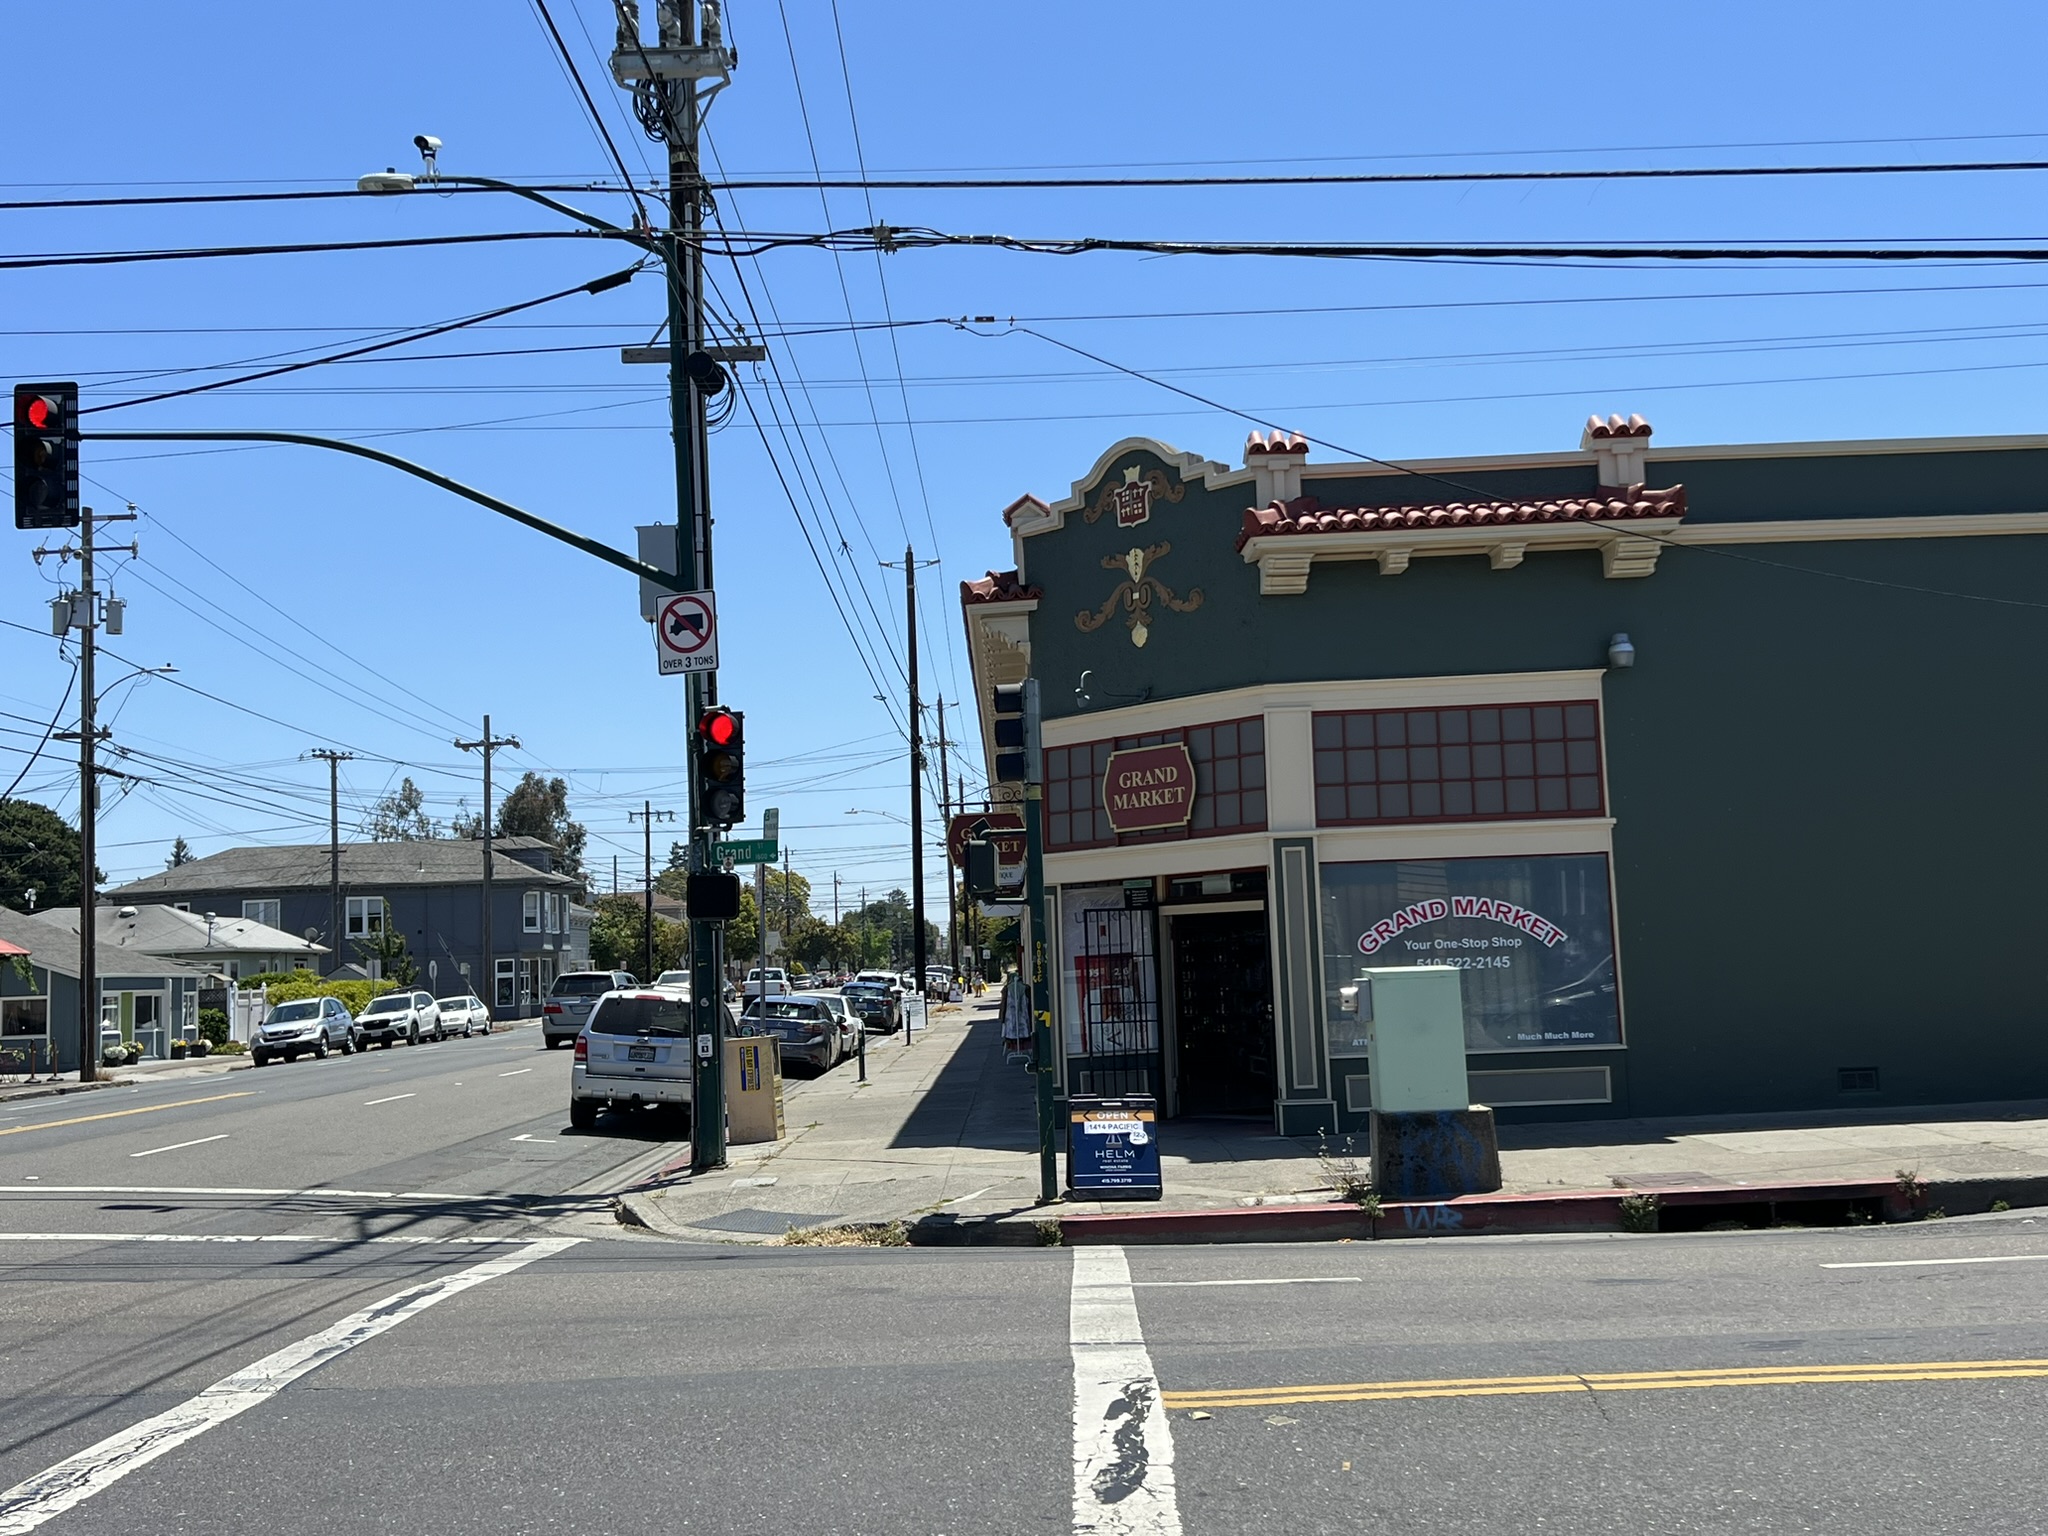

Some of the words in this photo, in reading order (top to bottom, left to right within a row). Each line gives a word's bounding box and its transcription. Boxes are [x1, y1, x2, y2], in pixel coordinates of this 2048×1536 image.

[663, 659, 683, 669] OVER
[685, 656, 692, 668] 3
[694, 655, 714, 666] TONS
[1118, 766, 1178, 789] GRAND
[1113, 786, 1186, 811] MARKET
[716, 845, 752, 861] Grand
[1357, 898, 1448, 955] GRAND
[1451, 895, 1569, 948] MARKET
[1404, 939, 1432, 951] Your
[1434, 938, 1489, 950] One-Stop
[1491, 936, 1523, 949] Shop
[1446, 955, 1511, 970] 522-2145
[1517, 1033, 1542, 1041] Much
[1544, 1031, 1569, 1040] Much
[1571, 1031, 1595, 1039] More
[1096, 1112, 1129, 1120] OPEN
[1095, 1149, 1135, 1159] HELM
